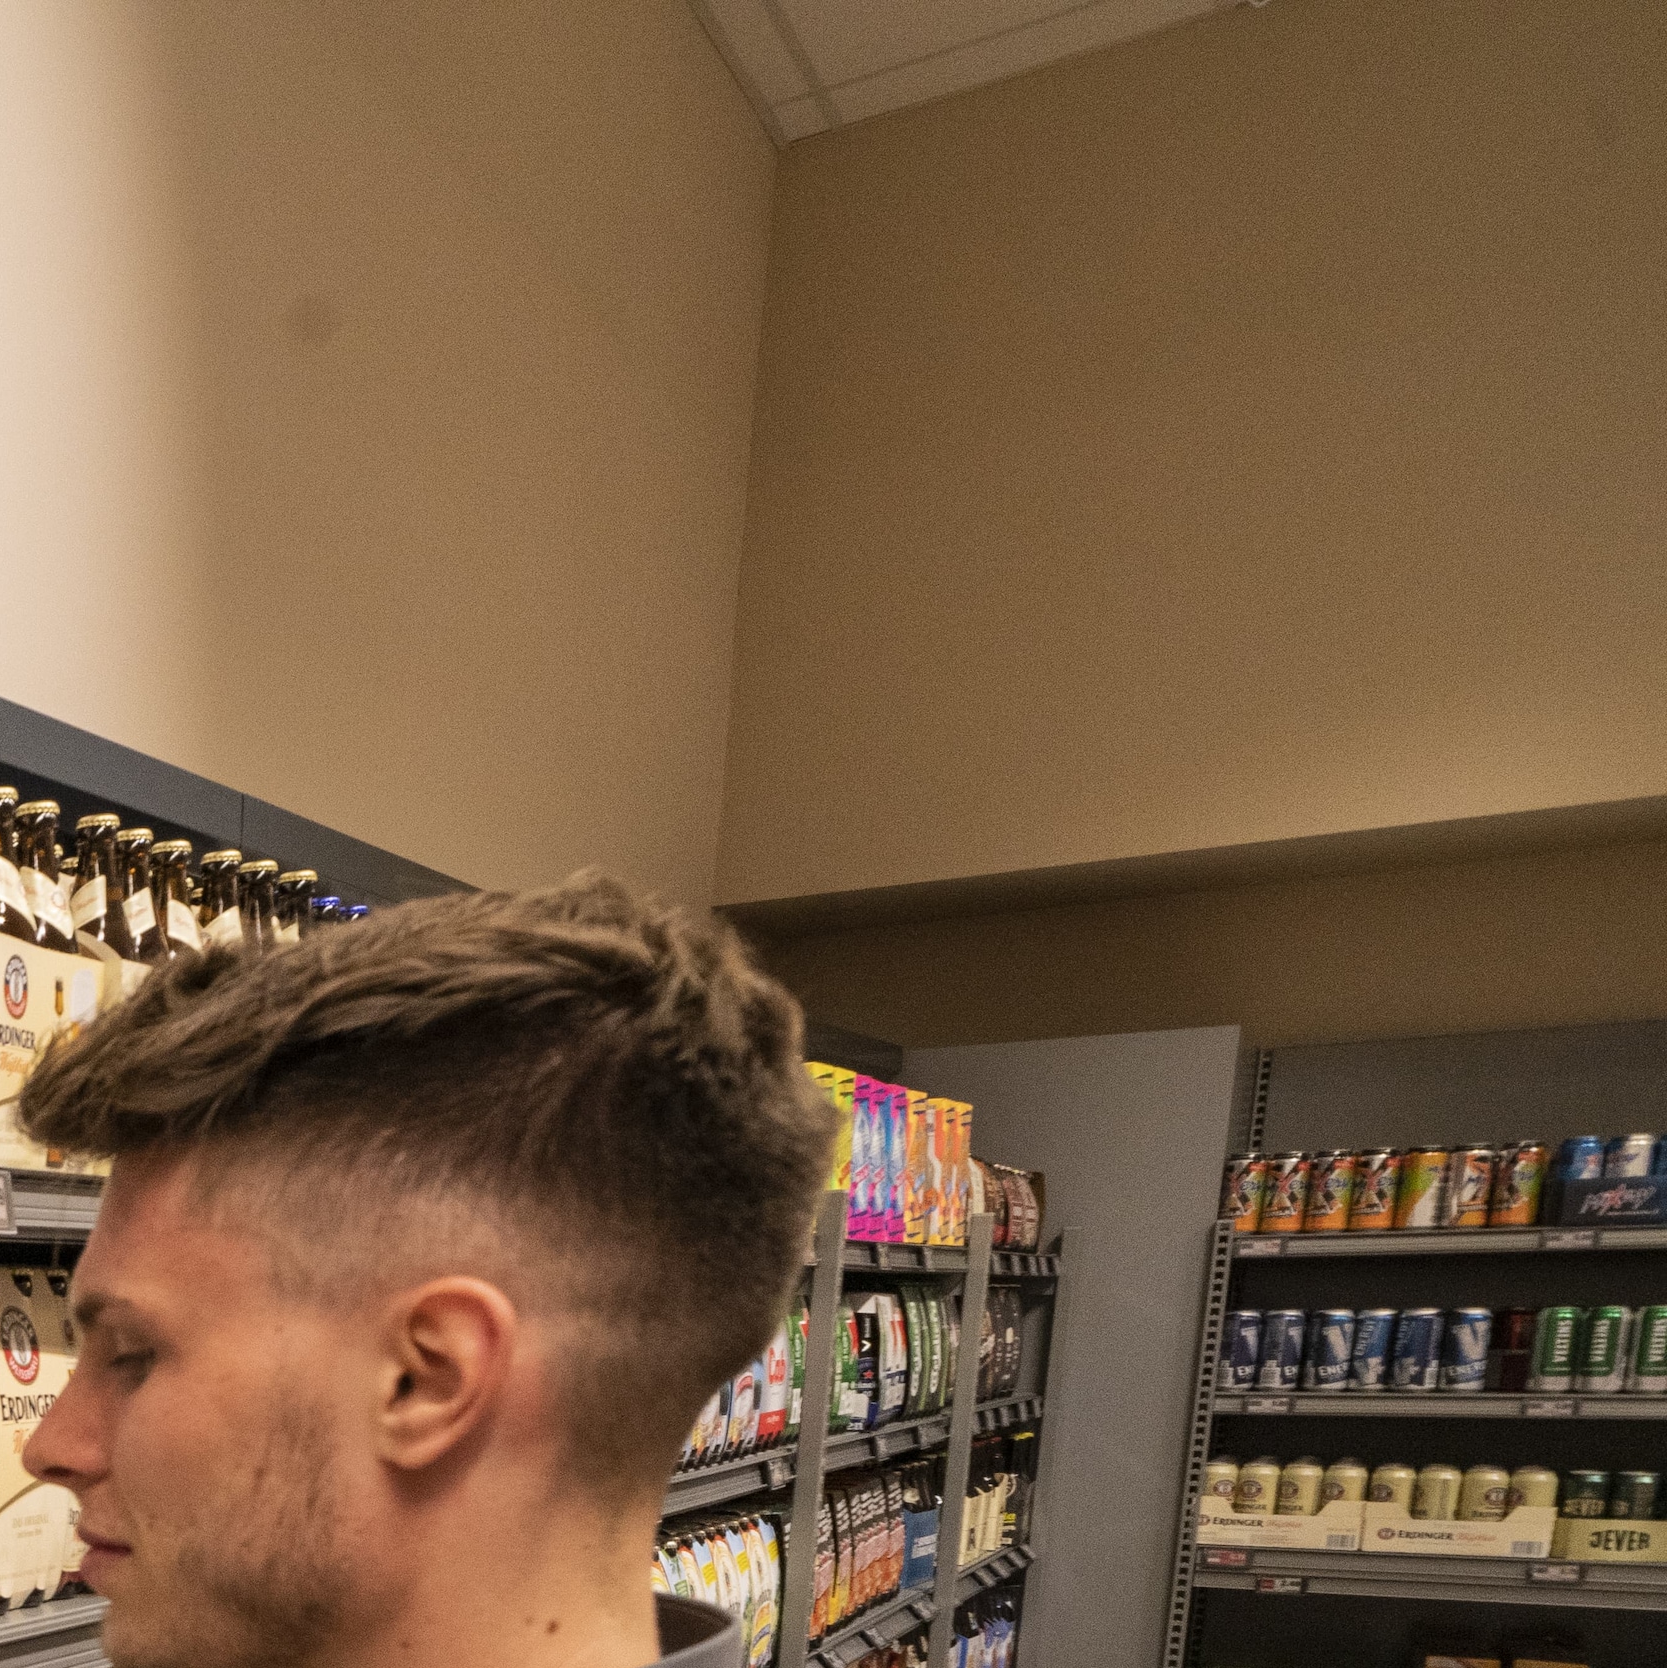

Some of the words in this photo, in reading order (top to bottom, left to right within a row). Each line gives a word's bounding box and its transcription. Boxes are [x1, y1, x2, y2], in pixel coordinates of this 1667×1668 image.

[1212, 1515, 1264, 1530] ERDINGER
[1397, 1528, 1454, 1543] ERDINGER
[1589, 1529, 1652, 1553] JEVER
